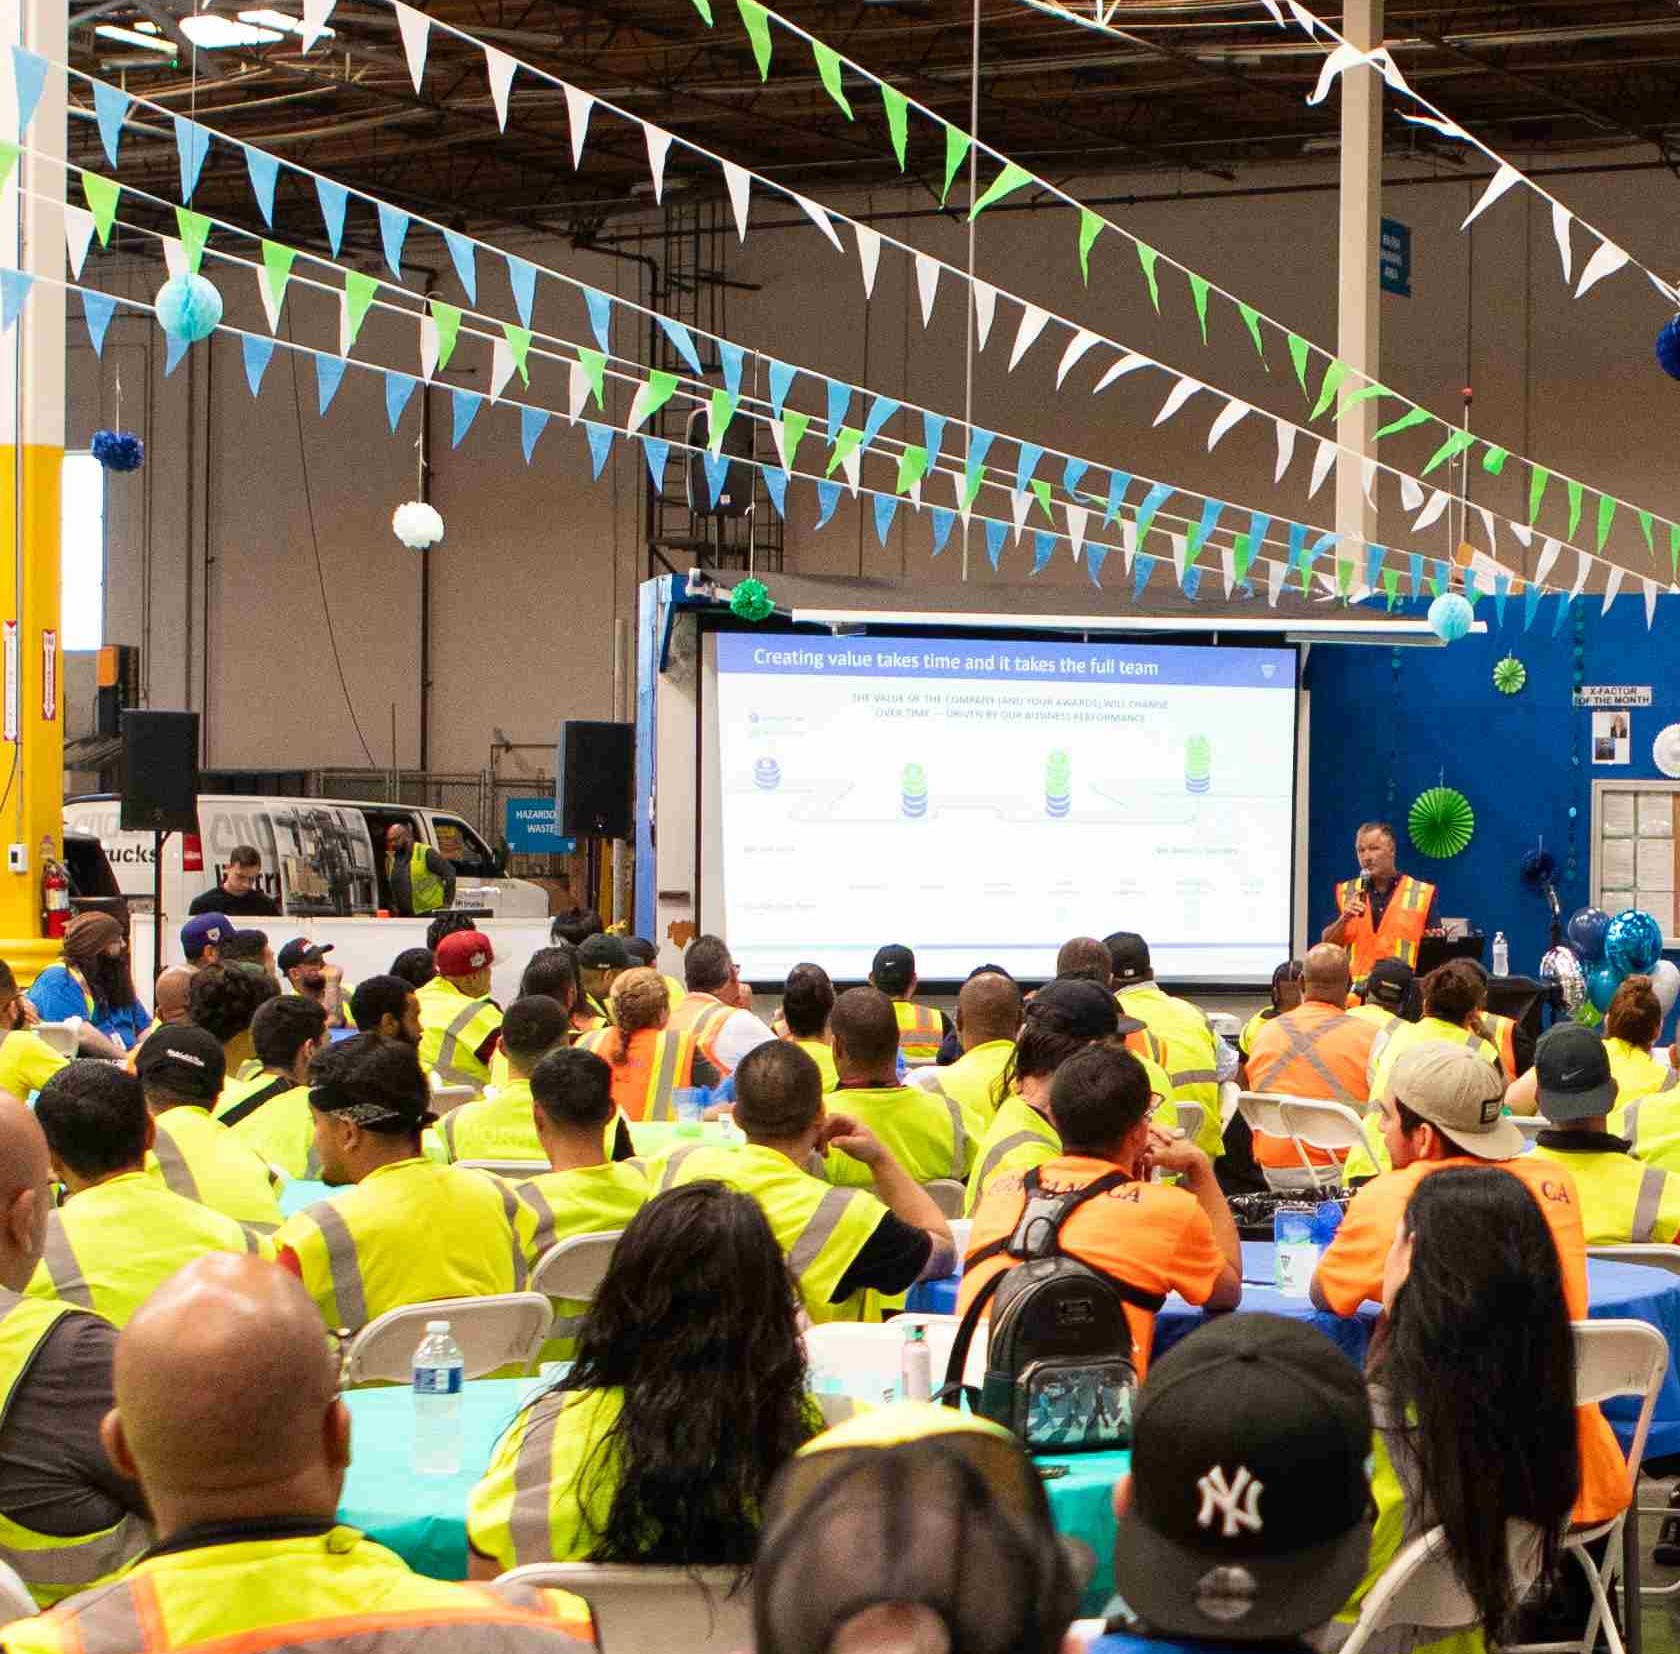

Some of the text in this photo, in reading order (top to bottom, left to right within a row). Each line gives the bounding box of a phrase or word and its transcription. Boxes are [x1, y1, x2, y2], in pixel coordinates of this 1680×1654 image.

[754, 648, 1158, 676] Creating value takes time and it takes the full team
[1595, 697, 1613, 705] THE
[1615, 696, 1648, 705] MONTH
[1541, 1181, 1570, 1204] CA
